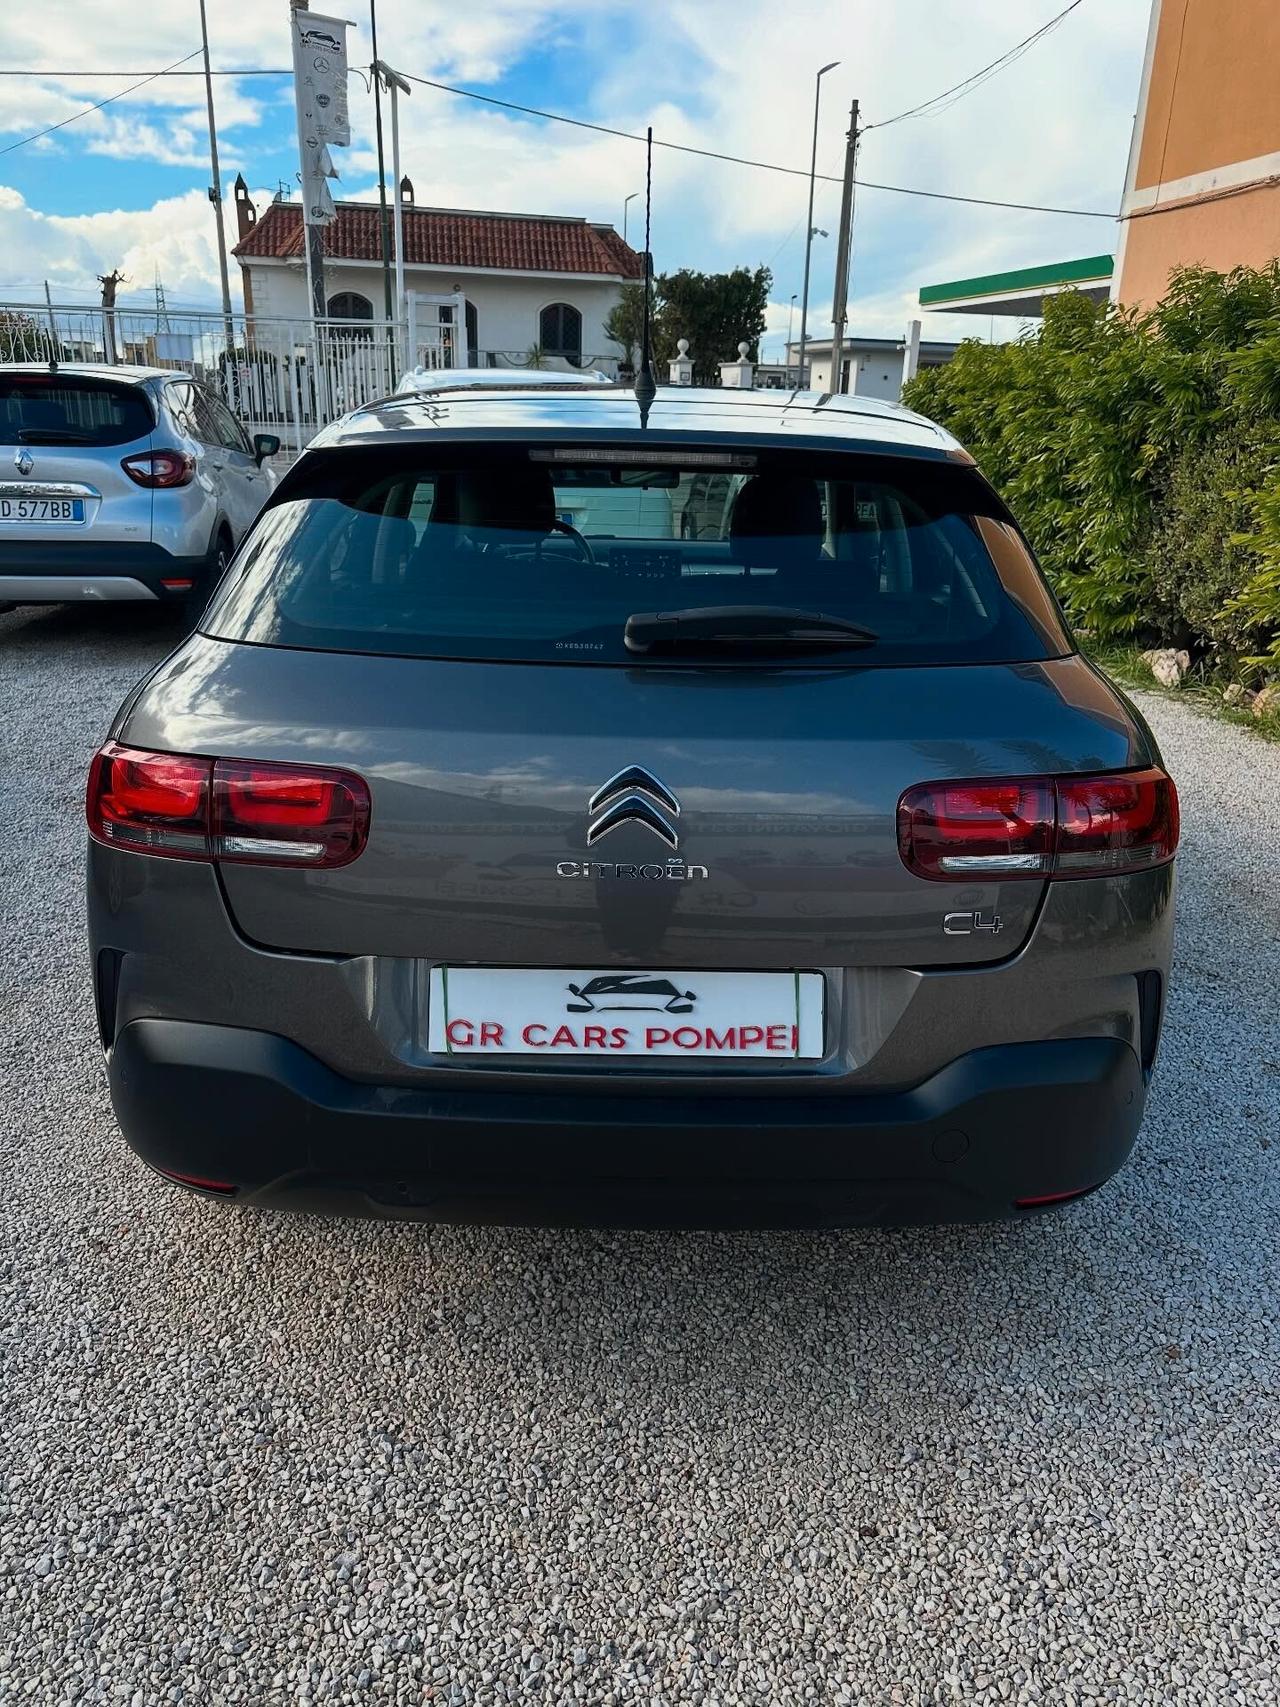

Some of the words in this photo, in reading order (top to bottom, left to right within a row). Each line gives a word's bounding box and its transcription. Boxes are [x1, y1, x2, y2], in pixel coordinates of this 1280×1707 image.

[943, 911, 1004, 935] C4
[446, 1019, 505, 1048] GR
[522, 1024, 630, 1049] CARS
[645, 1026, 799, 1051] POMPEI
